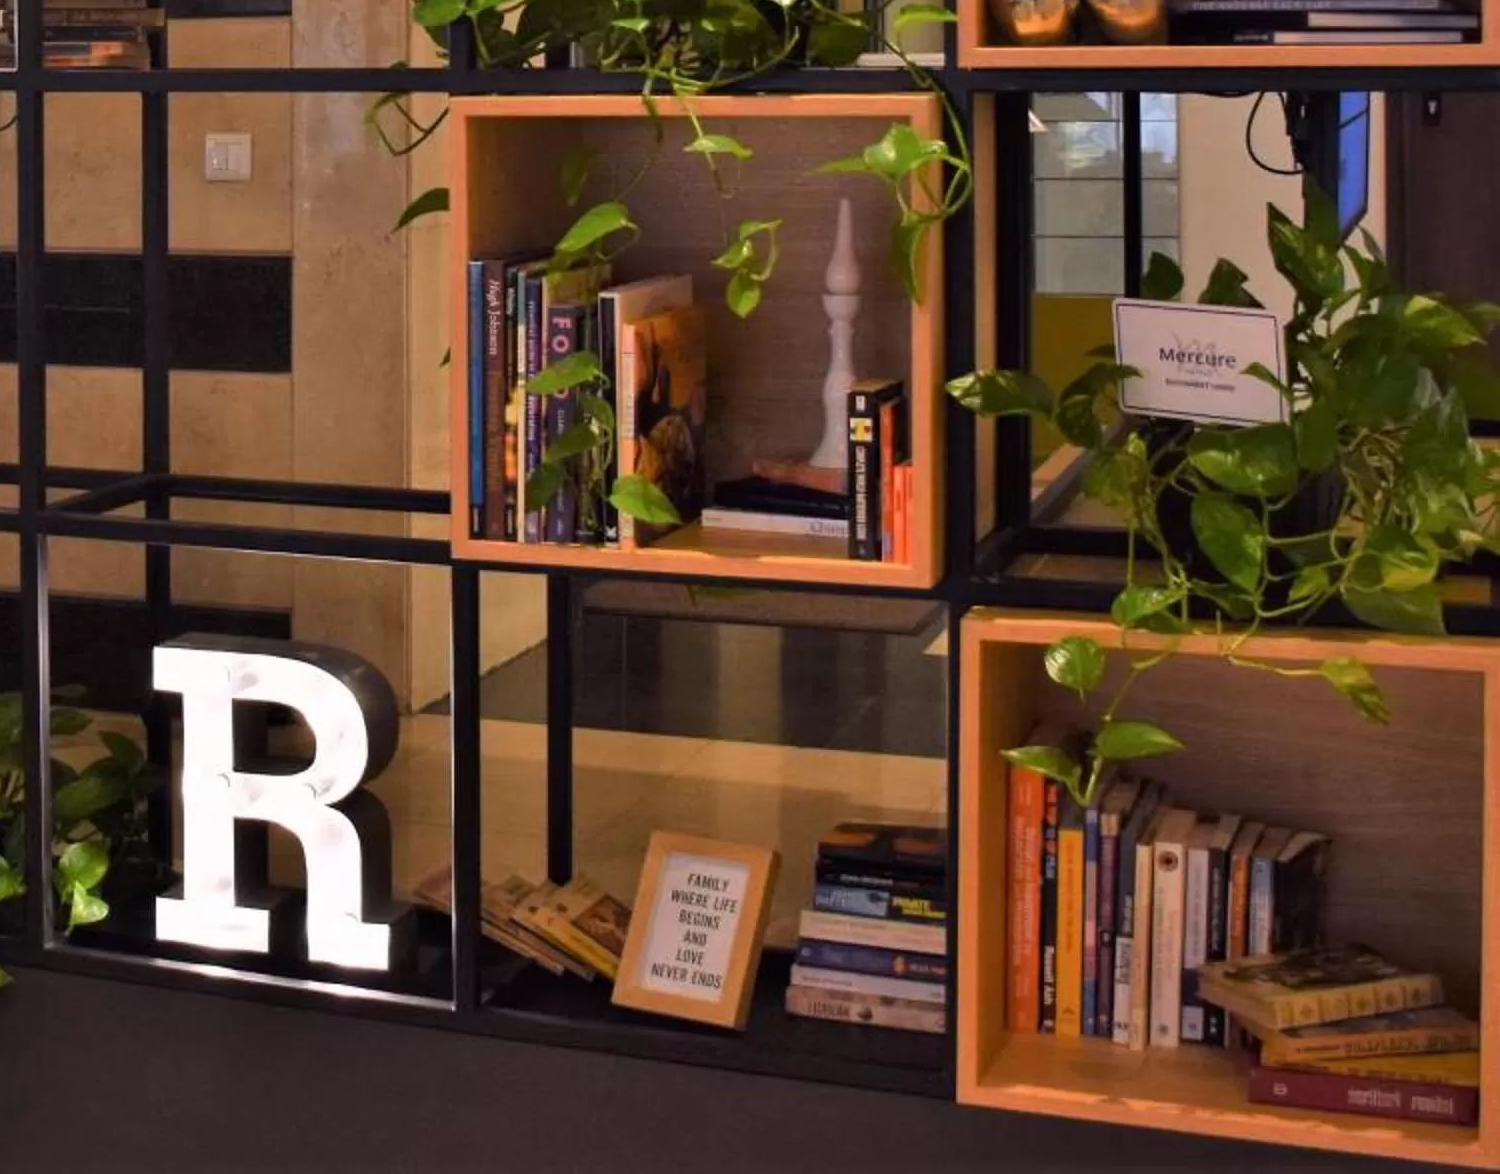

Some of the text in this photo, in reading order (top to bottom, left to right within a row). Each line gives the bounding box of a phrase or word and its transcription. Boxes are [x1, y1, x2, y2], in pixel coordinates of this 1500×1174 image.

[1159, 347, 1237, 369] Mercure
[153, 645, 391, 971] R
[687, 873, 730, 892] FAMILY
[671, 889, 739, 914] WHERE LIFE
[678, 909, 721, 930] BEGINS
[683, 930, 707, 947] AND
[675, 947, 705, 967] LOVE
[651, 962, 722, 990] NEVER ENDS
